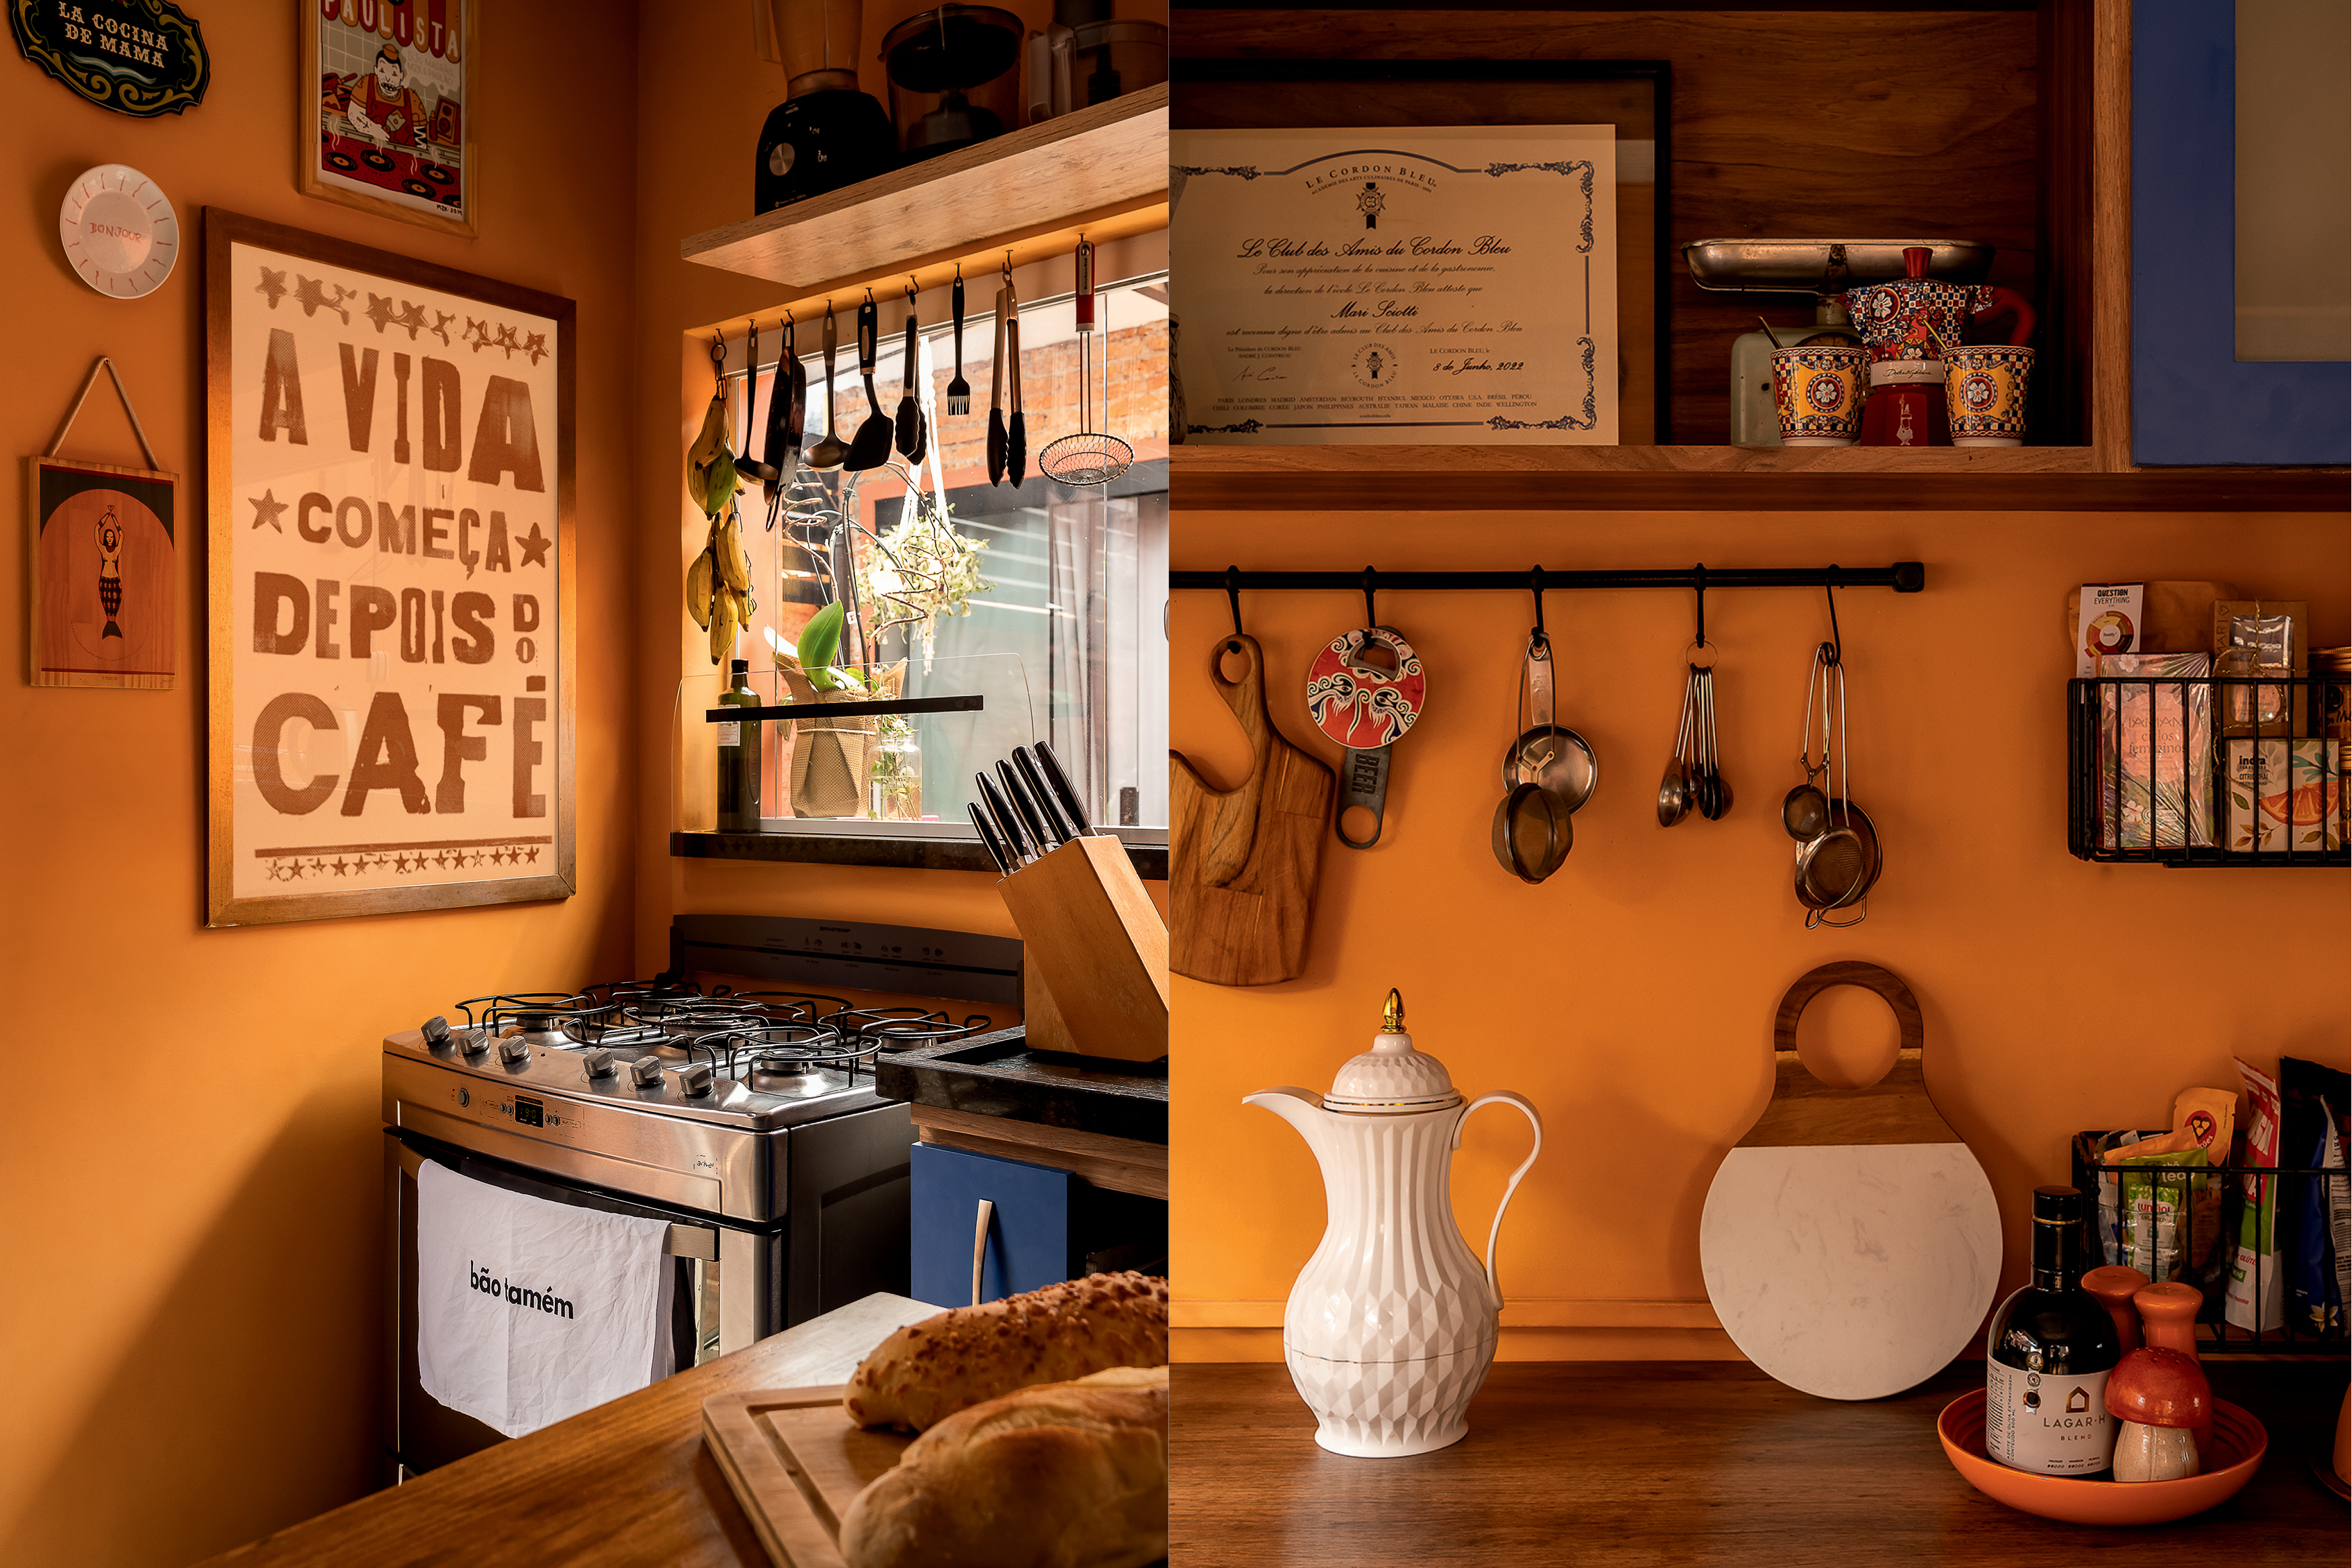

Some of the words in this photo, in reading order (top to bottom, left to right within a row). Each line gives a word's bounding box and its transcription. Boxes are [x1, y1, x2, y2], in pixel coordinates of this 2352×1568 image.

[58, 1, 85, 24] LA
[91, 13, 169, 52] COCINA
[64, 22, 92, 45] DE
[99, 34, 165, 69] MAMA
[1305, 176, 1323, 189] LE
[1330, 165, 1392, 179] CORDON
[89, 222, 142, 244] BONJOUR
[1237, 238, 1264, 258] Le
[1267, 238, 1307, 258] Club
[1307, 241, 1330, 256] des
[1335, 237, 1383, 257] Amis
[1386, 239, 1405, 255] du
[1409, 236, 1463, 256] Cordon
[1467, 235, 1512, 255] Bleu
[1253, 262, 1276, 275] Pour
[1352, 263, 1362, 273] de
[1364, 263, 1373, 273] la
[1375, 265, 1406, 273] cuisine
[1407, 264, 1419, 273] et
[1418, 262, 1429, 273] de
[1430, 262, 1439, 272] la
[1264, 284, 1273, 294] la
[1274, 284, 1312, 294] direction
[1314, 284, 1325, 294] de
[1355, 281, 1372, 294] Le
[1373, 281, 1406, 294] Cordon
[1409, 280, 1435, 294] Bleu
[1436, 284, 1466, 293] atteste
[1466, 287, 1483, 296] que
[1330, 300, 1369, 318] Mari
[1372, 300, 1419, 318] Sciotti
[1226, 327, 1242, 336] est
[1277, 325, 1303, 340] digne
[1330, 324, 1358, 335] admis
[1375, 322, 1399, 335] Club
[1398, 323, 1412, 334] des
[1415, 321, 1444, 334] Amis
[1446, 323, 1458, 333] du
[1461, 320, 1493, 333] Cordon
[1496, 320, 1524, 333] Bleu
[1433, 363, 1441, 372] 8
[1442, 359, 1454, 371] de
[1495, 361, 1524, 371] 2022
[259, 326, 309, 446] A
[338, 341, 546, 494] VIDA
[297, 491, 512, 581] COMEÇA
[2093, 597, 2130, 605] EVERYTHING
[2097, 588, 2129, 597] QUESTION
[252, 570, 496, 665] DEPOIS
[2142, 730, 2174, 741] clos
[251, 674, 548, 820] CAFÉ
[2128, 742, 2185, 754] femnino
[2239, 755, 2266, 765] inda
[1352, 753, 1380, 795] BEER
[470, 1259, 501, 1297] bão
[504, 1276, 574, 1320] tamém
